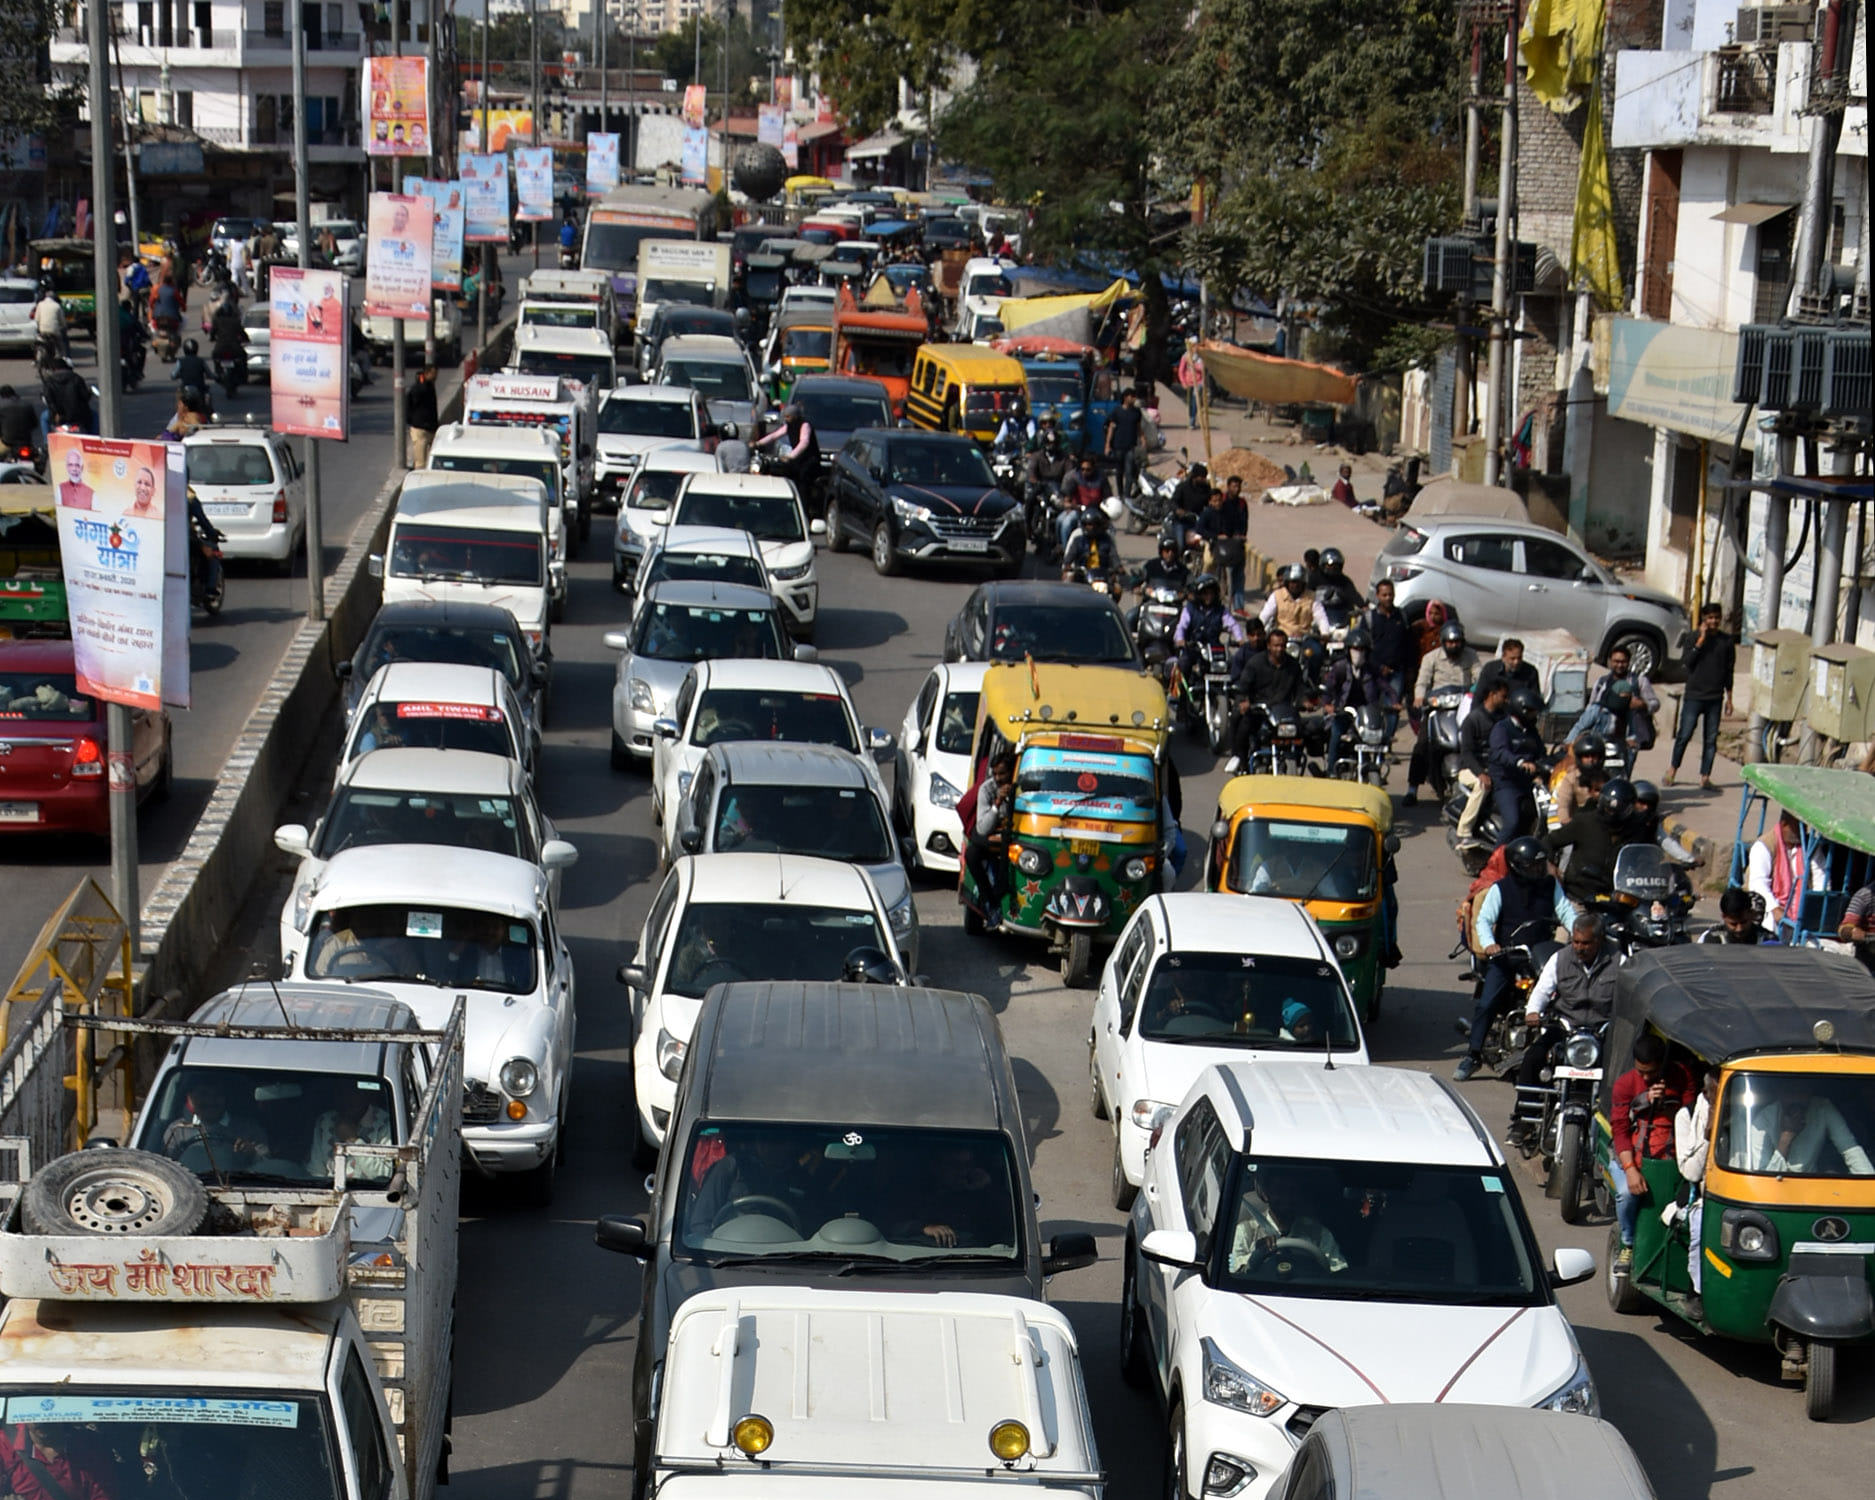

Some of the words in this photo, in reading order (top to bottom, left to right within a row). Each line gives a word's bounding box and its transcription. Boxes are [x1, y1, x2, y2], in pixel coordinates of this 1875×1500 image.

[493, 385, 505, 394] YA
[510, 386, 551, 397] HUSAIN
[74, 517, 108, 546] गंगा
[97, 546, 138, 571] यात्रा
[1626, 877, 1668, 887] POLICE
[49, 1261, 120, 1296] जय
[172, 1259, 276, 1299] शारदा
